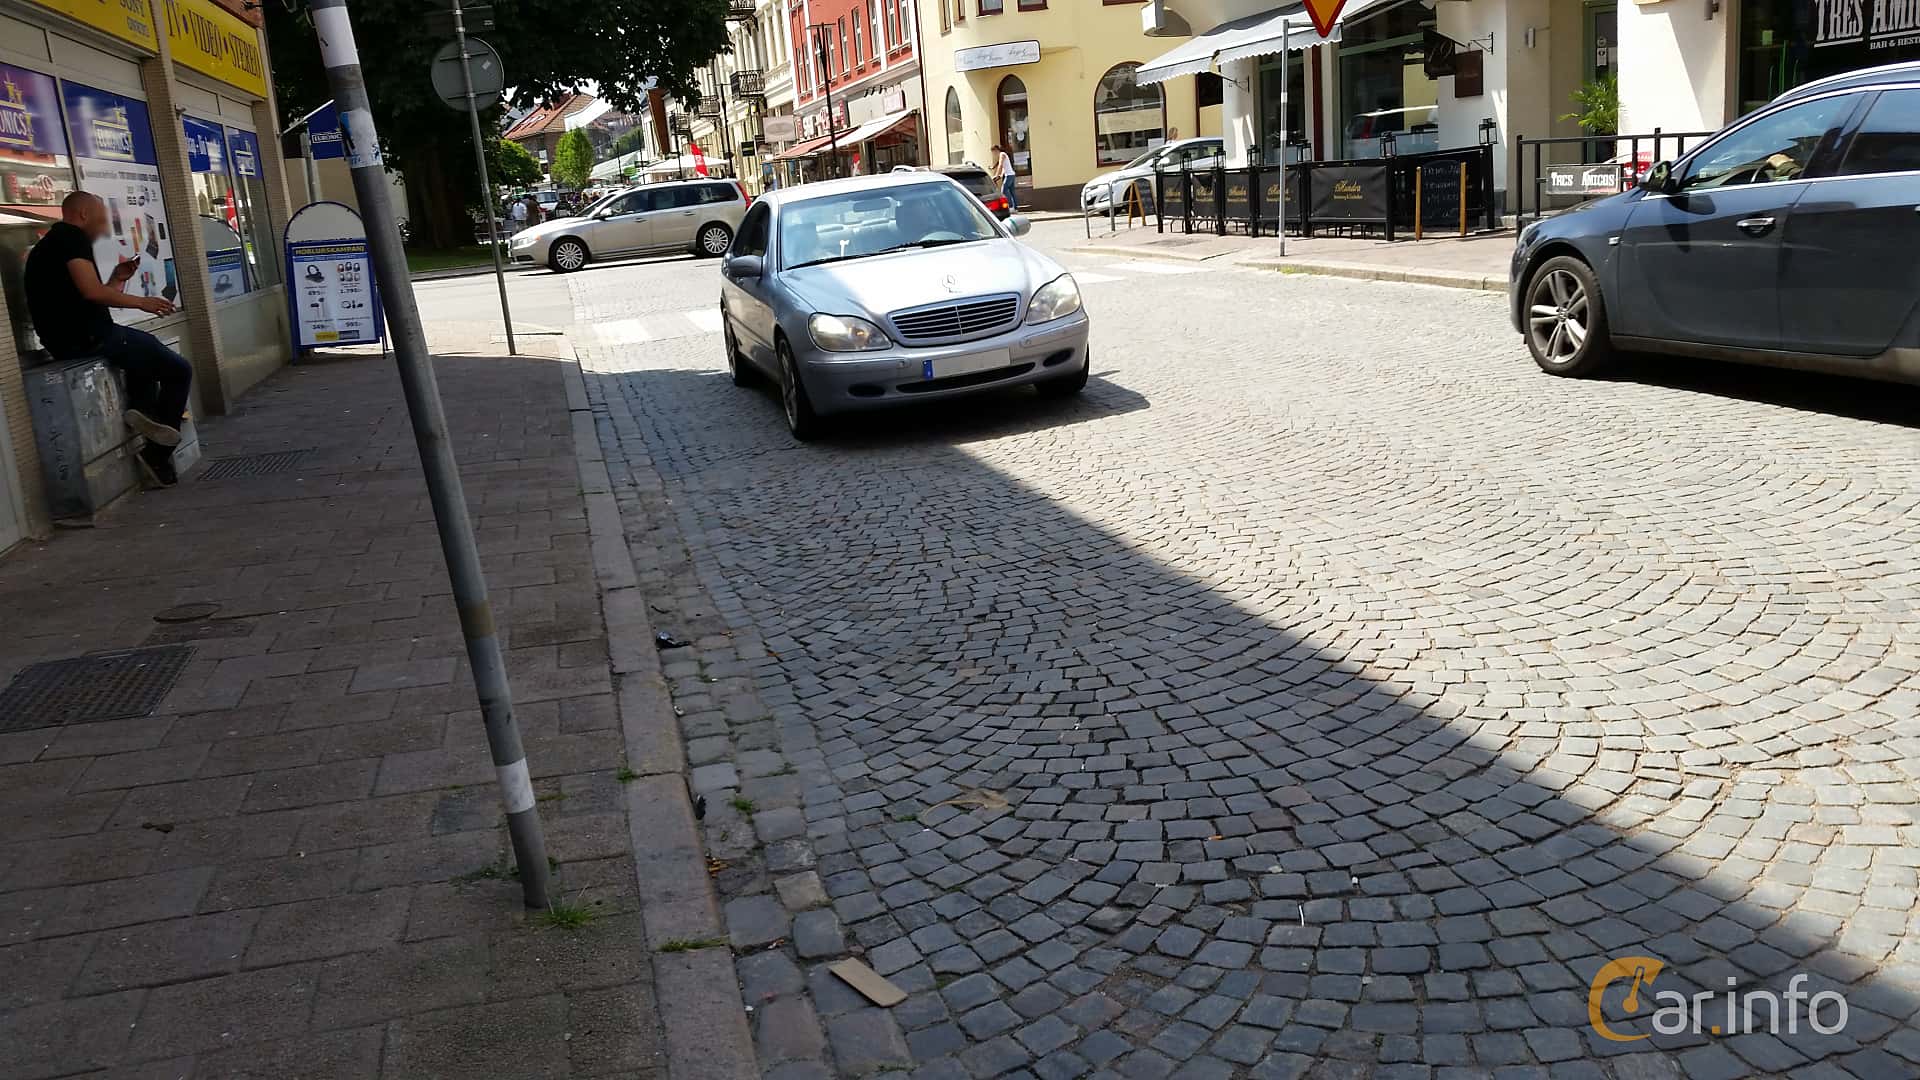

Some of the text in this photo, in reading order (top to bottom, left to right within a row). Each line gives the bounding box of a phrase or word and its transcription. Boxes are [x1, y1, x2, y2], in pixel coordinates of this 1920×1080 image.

[1813, 0, 1863, 41] TRES
[163, 0, 182, 39] TV
[188, 8, 223, 60] VIDEO
[228, 32, 262, 79] STEREO
[1870, 40, 1888, 50] BAR
[1889, 39, 1897, 47] &
[1551, 172, 1574, 186] TRES
